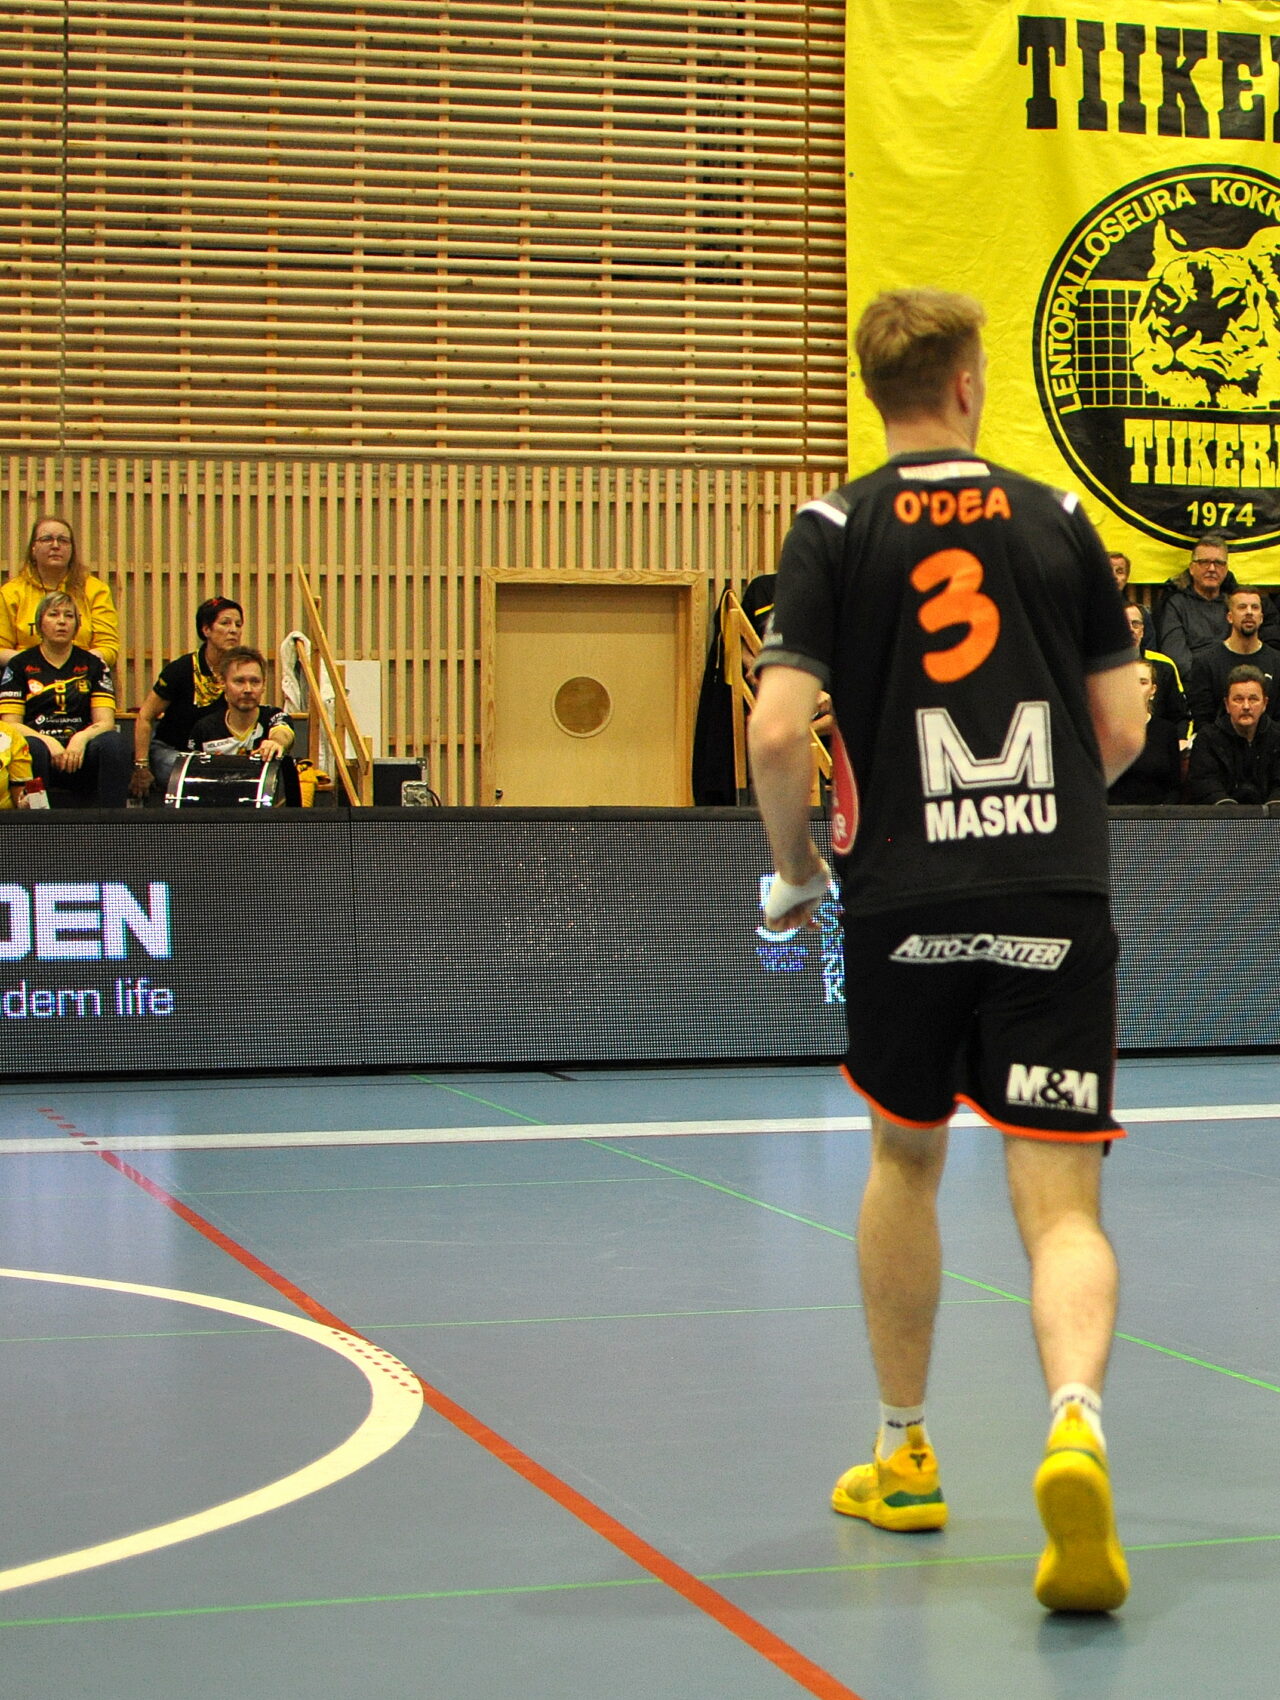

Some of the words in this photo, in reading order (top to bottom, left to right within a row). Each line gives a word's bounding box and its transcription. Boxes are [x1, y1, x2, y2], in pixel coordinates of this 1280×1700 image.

[1048, 183, 1196, 415] LENTOPALLOSEURA
[894, 488, 1011, 525] O'DEA
[1187, 501, 1256, 527] 1974
[910, 547, 1001, 683] 3
[924, 794, 1058, 843] MASKU
[114, 976, 176, 1016] life
[1007, 1063, 1099, 1110] M&M
